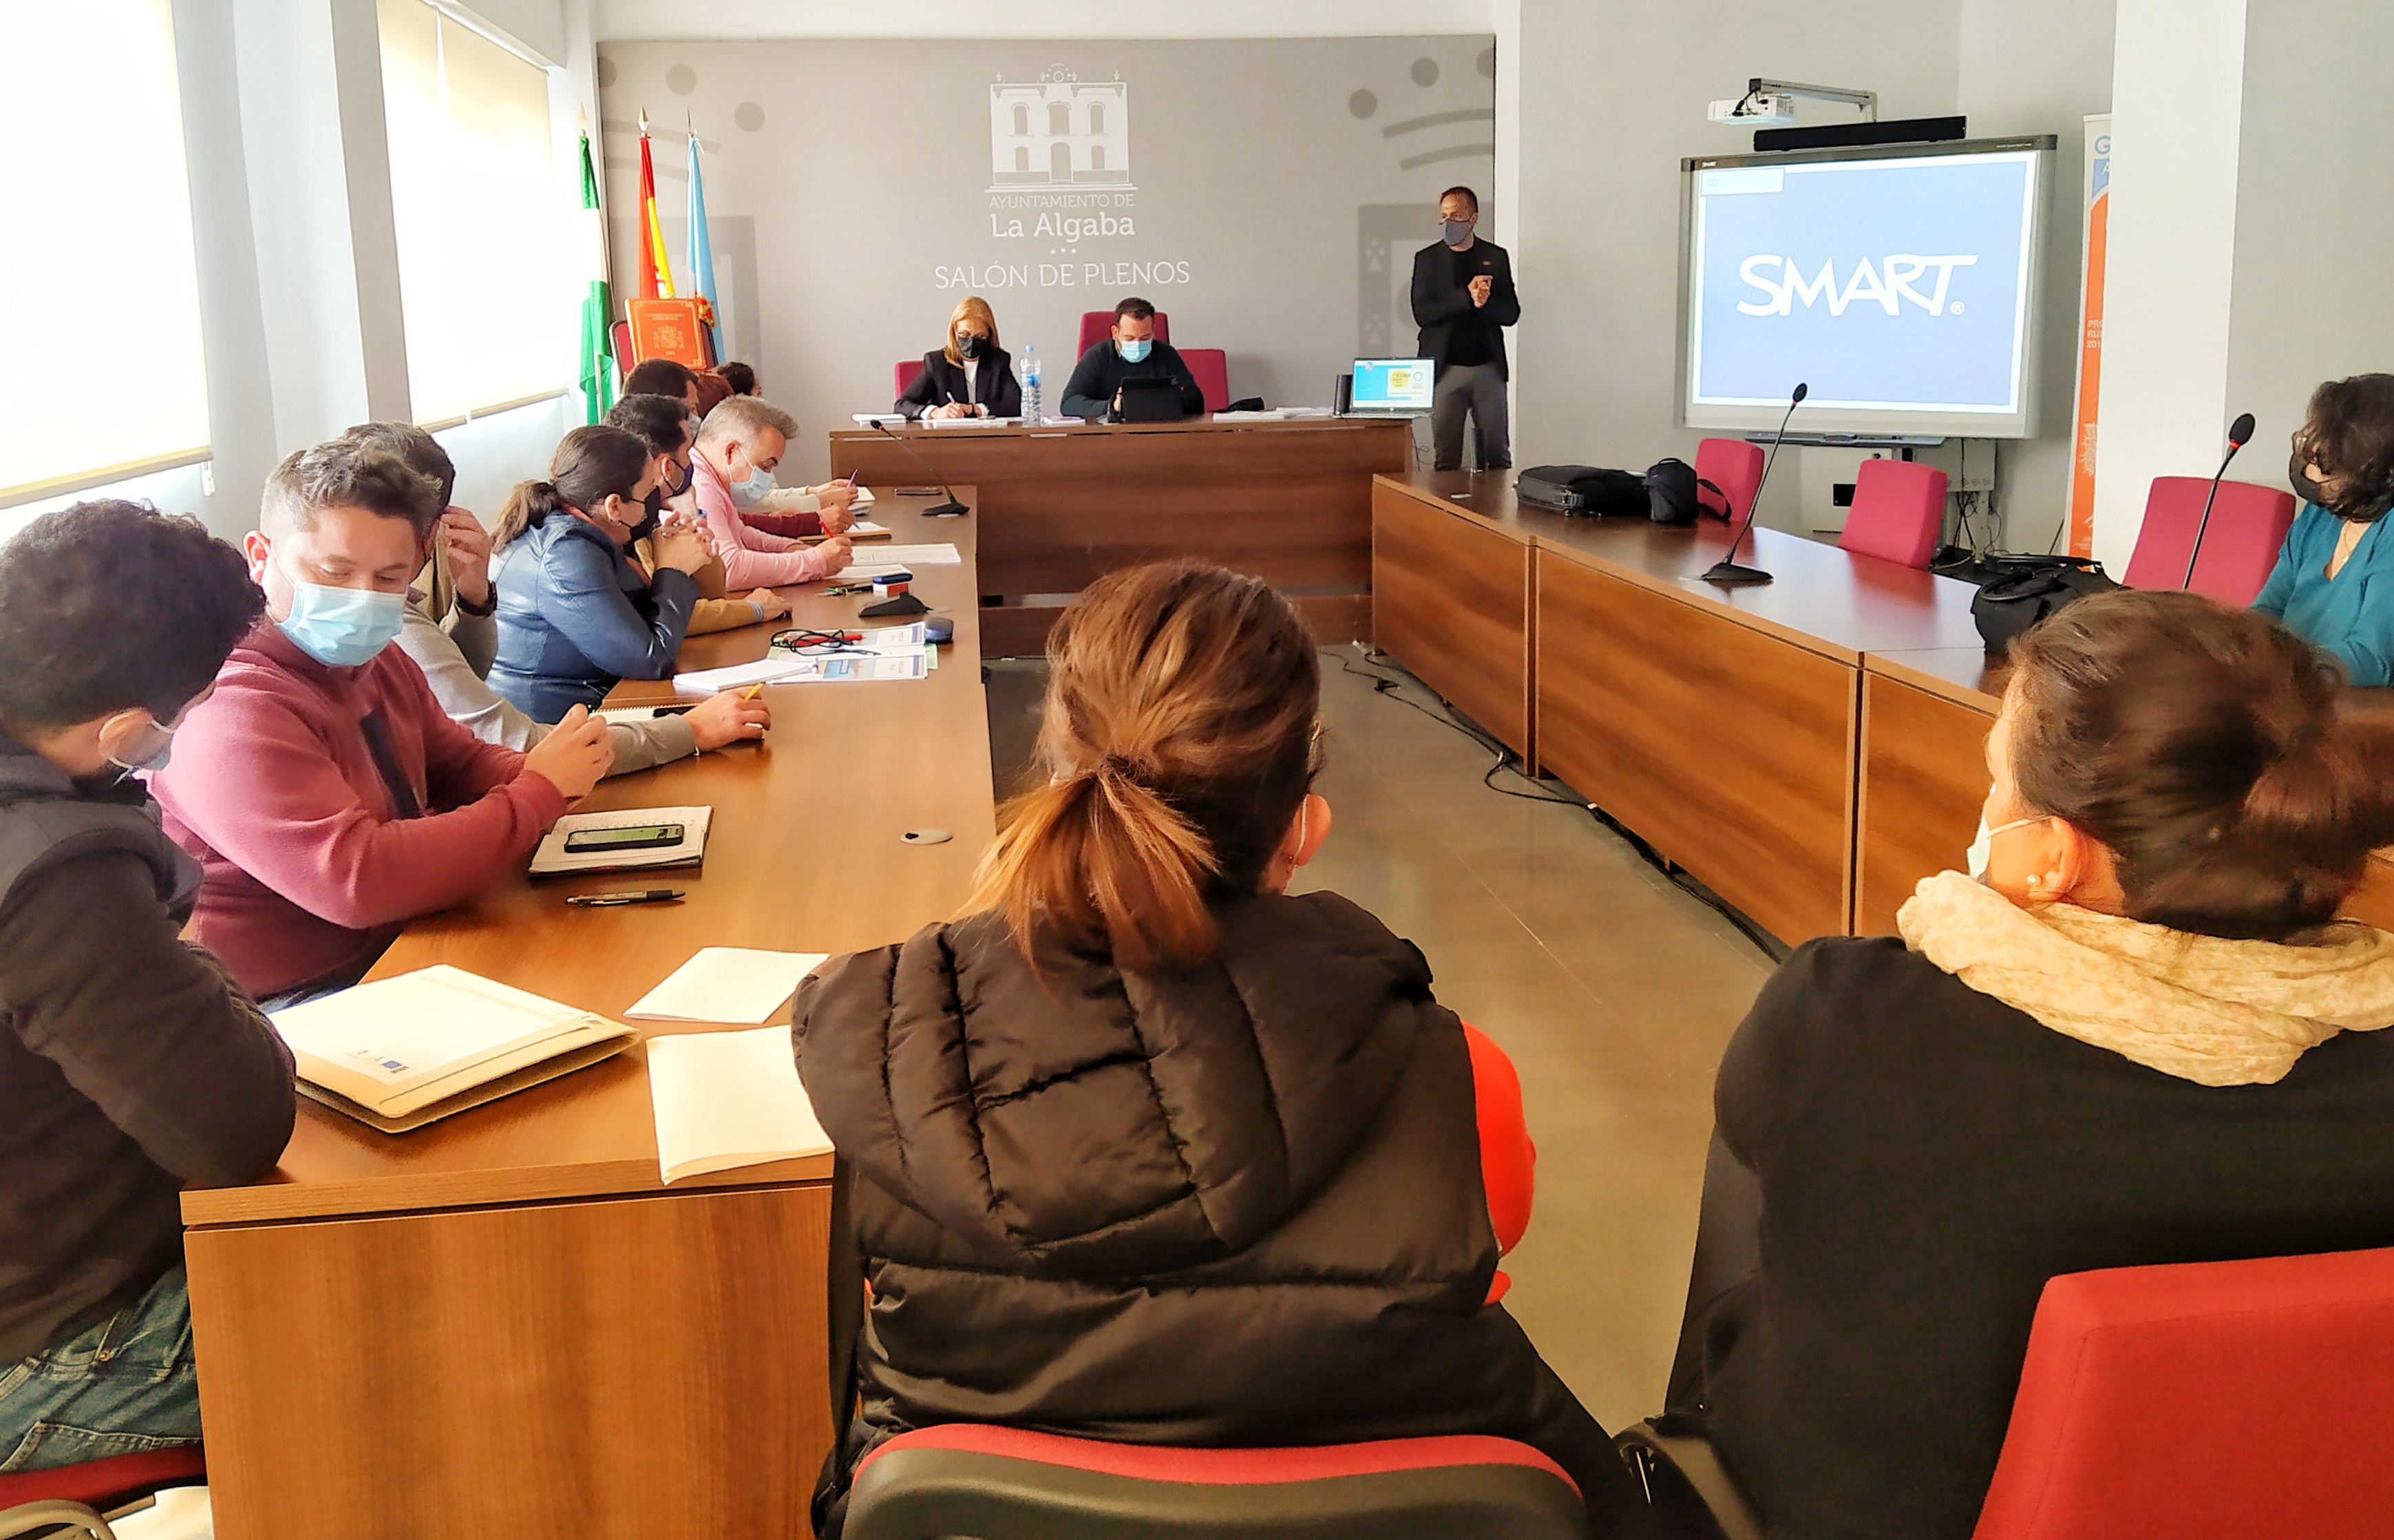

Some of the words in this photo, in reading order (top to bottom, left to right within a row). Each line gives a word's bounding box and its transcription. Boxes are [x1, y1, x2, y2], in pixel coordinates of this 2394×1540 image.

[989, 195, 1110, 208] AYUNTAMIENTO
[1115, 194, 1134, 206] DE
[991, 213, 1024, 237] La
[1034, 212, 1135, 242] Algaba
[935, 260, 1028, 288] SALÓN
[1039, 264, 1075, 287] DE
[1083, 261, 1191, 286] PLENOS
